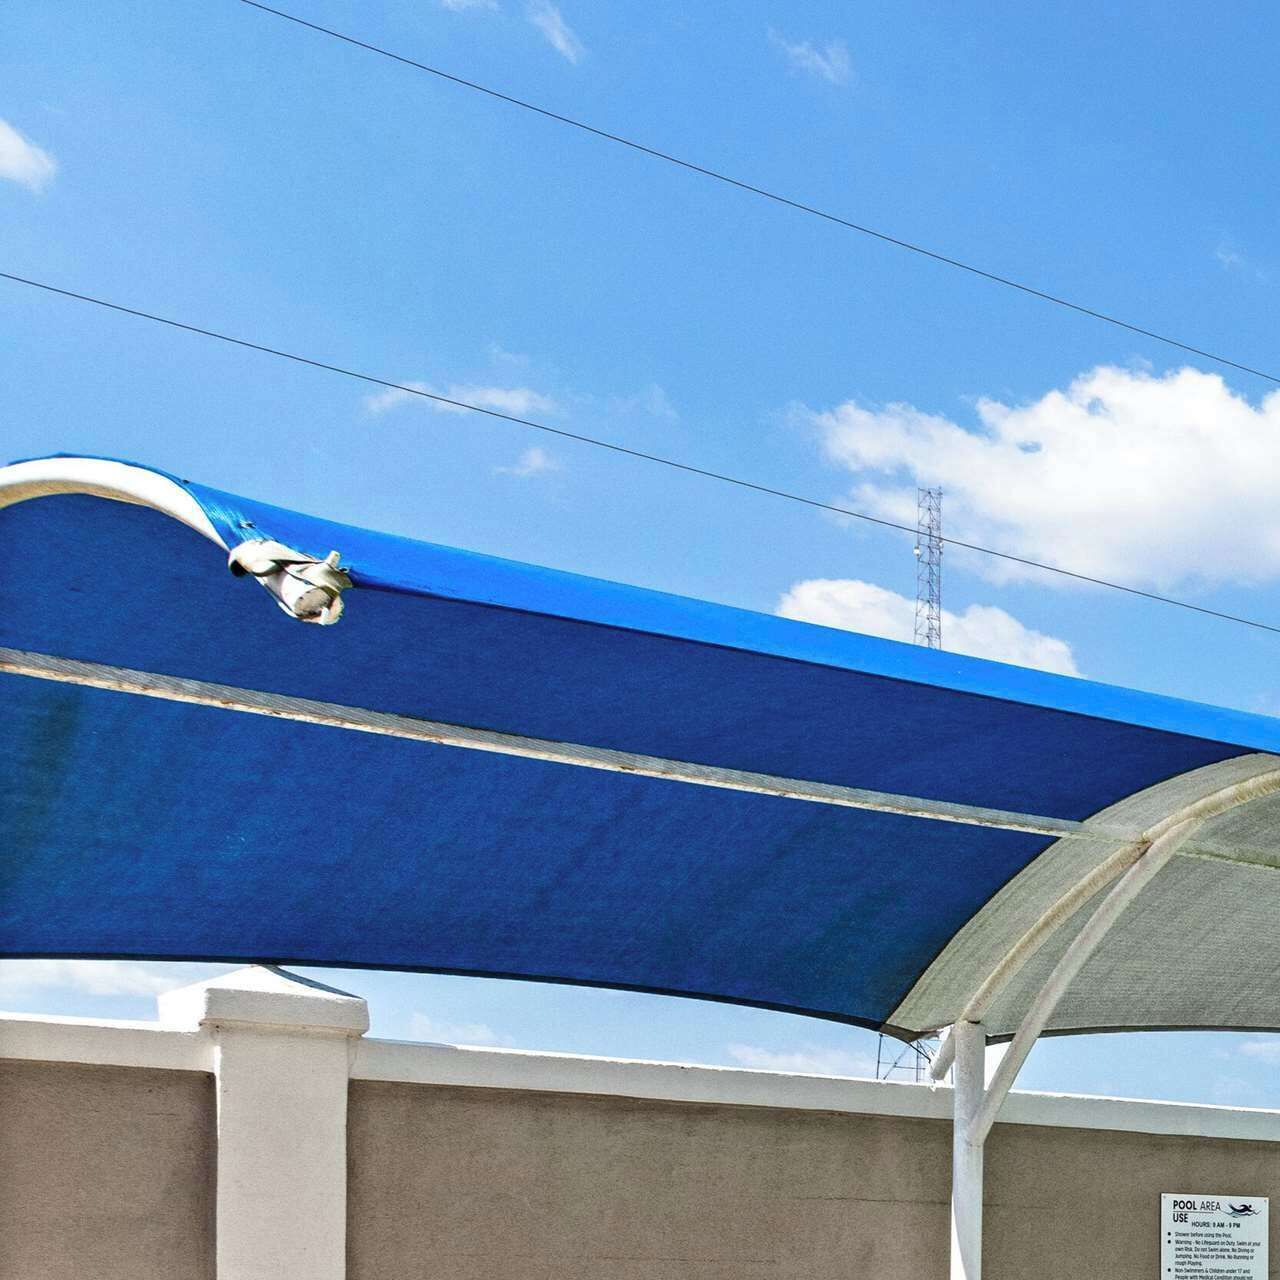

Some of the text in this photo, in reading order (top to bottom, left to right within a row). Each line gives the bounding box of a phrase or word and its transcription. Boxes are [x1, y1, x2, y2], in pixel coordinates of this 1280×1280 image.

[1173, 1200, 1221, 1211] POOL AREA
[1173, 1213, 1188, 1222] USE
